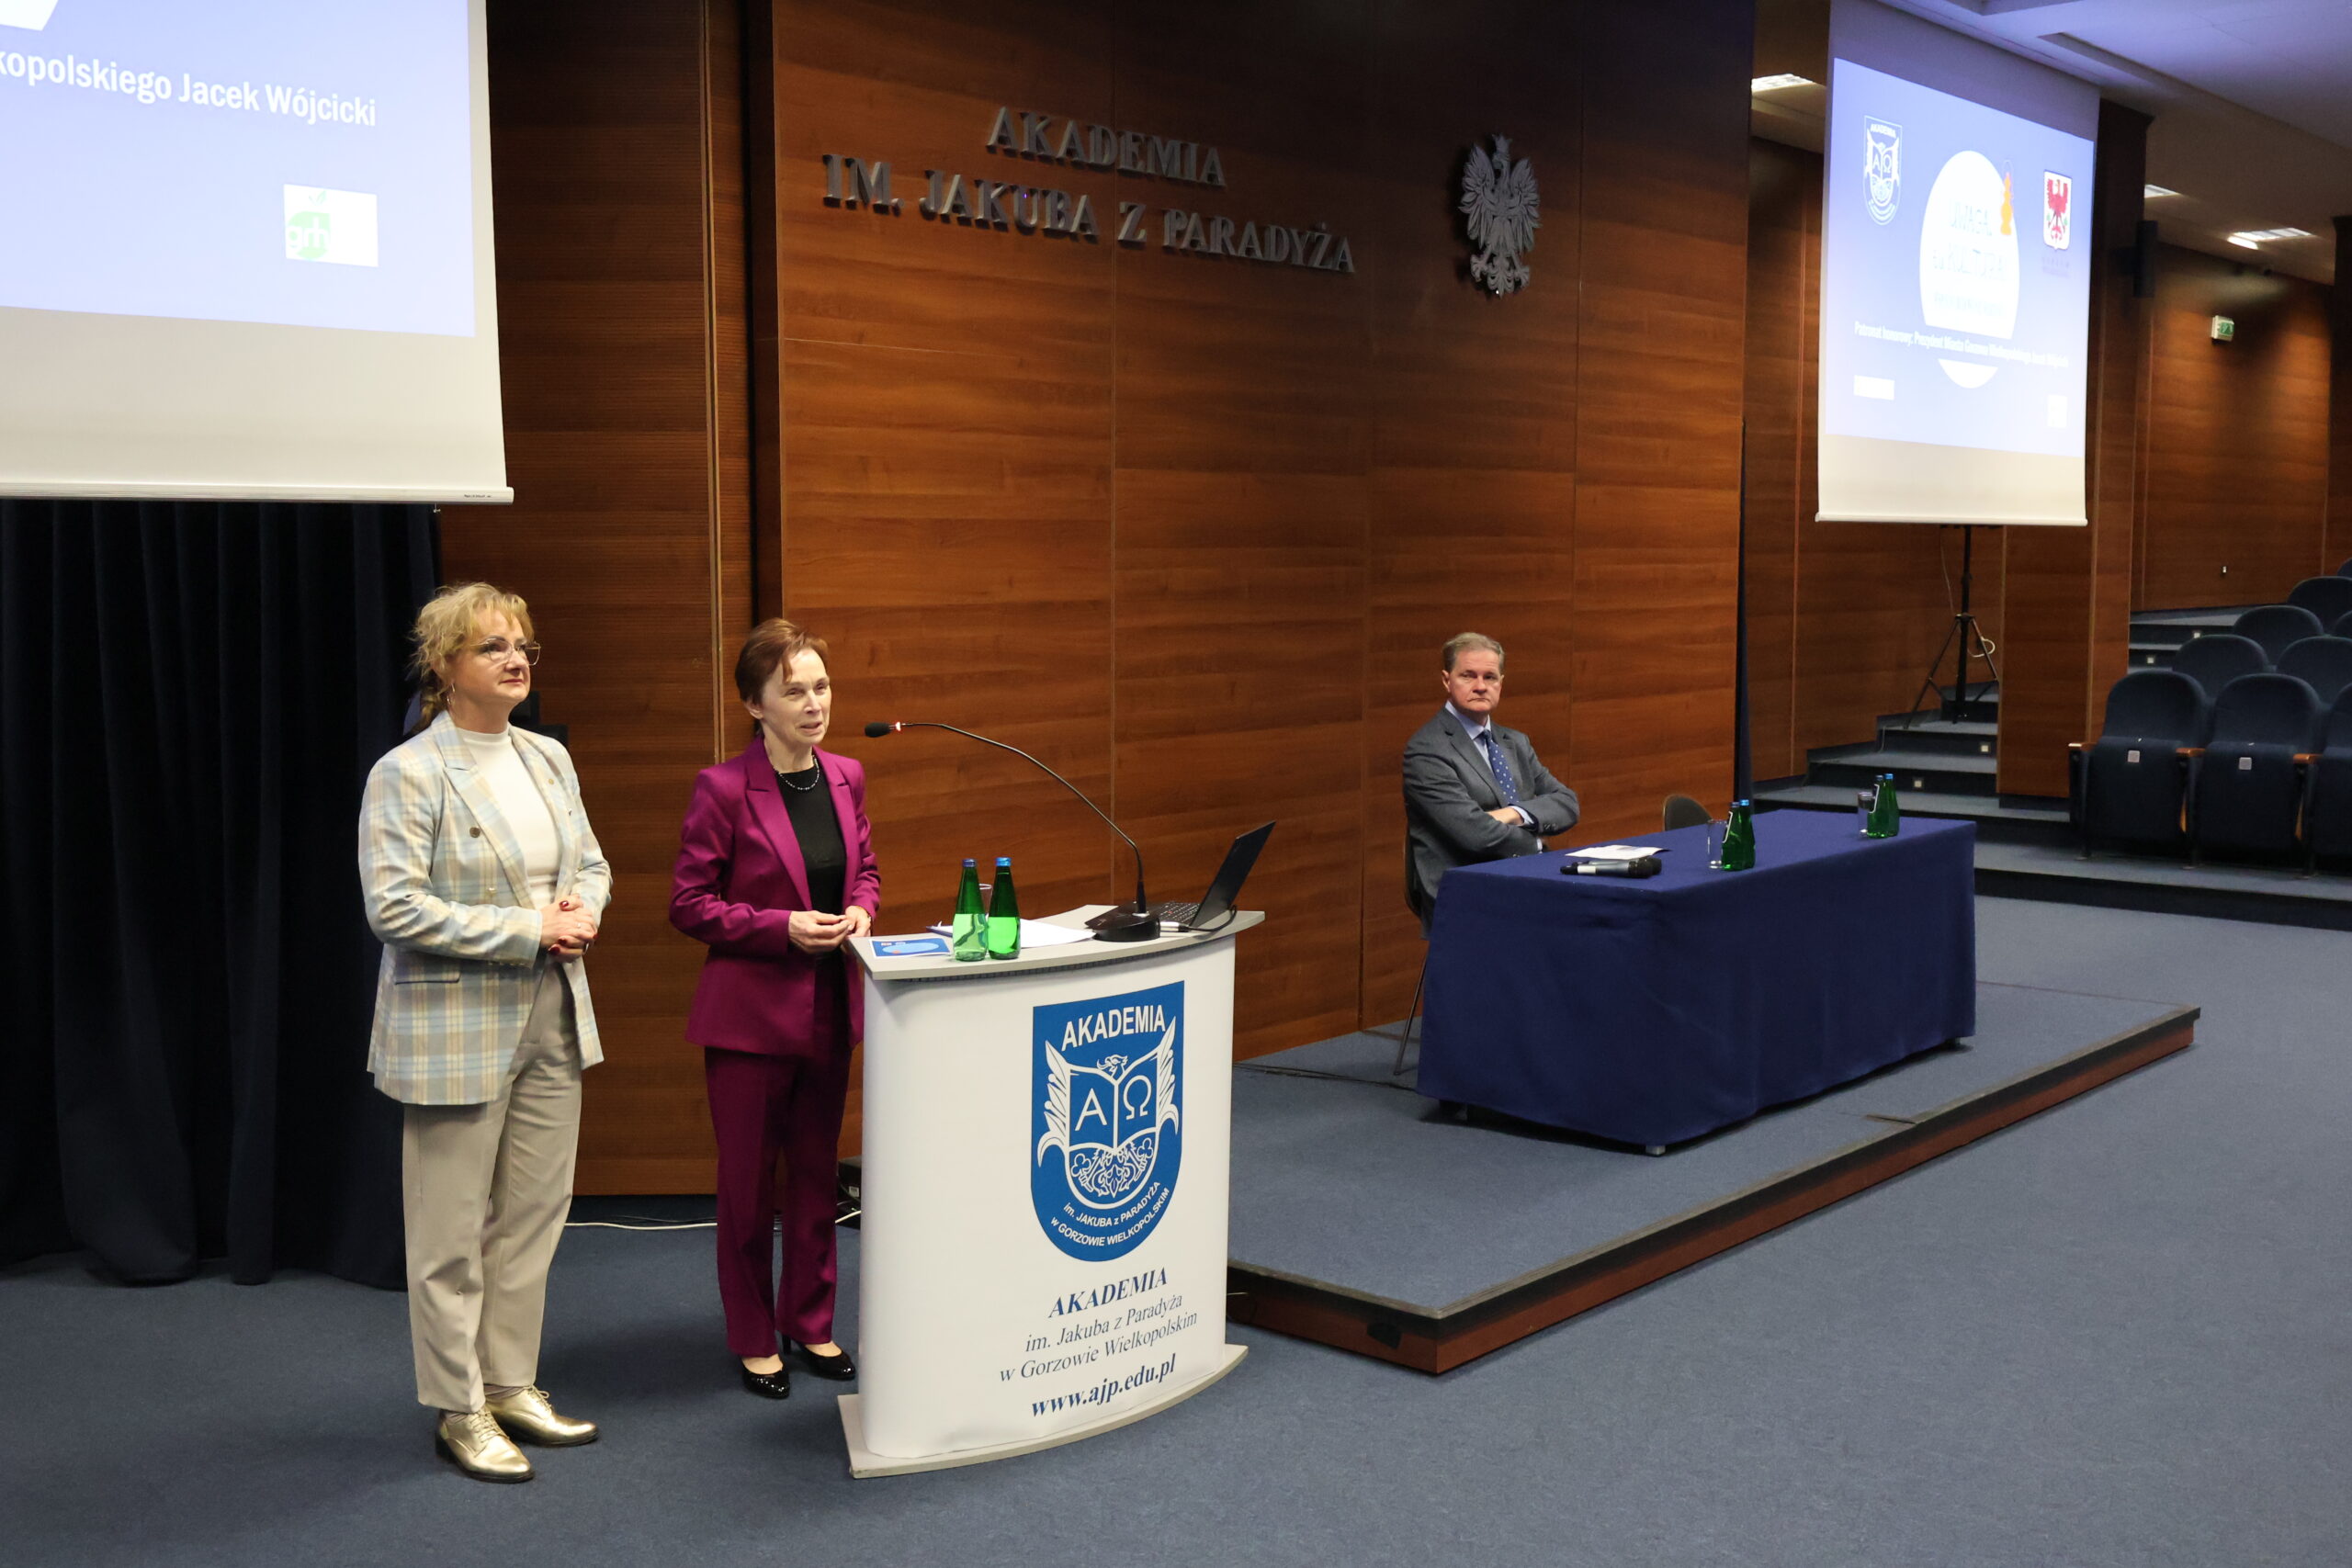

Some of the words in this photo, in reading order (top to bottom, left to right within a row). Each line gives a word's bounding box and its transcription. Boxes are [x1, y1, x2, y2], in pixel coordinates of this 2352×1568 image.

[177, 73, 260, 111] Jacek
[265, 85, 377, 126] Wójcicki
[986, 106, 1227, 187] AKADEMIA
[821, 152, 904, 217] IM.
[919, 169, 1100, 243] JAKUBA
[1117, 201, 1148, 243] Z
[1161, 208, 1355, 274] PARADYŻA
[1061, 1005, 1166, 1051] AKADEMIA
[1058, 1223, 1105, 1247] GORZOWIE
[1106, 1188, 1170, 1245] WIELKOPOLSKIM
[1063, 1202, 1075, 1220] im.
[1076, 1211, 1113, 1227] JAKUBA
[1120, 1181, 1160, 1223] PARADYŻA
[1025, 1334, 1051, 1352] im.
[1057, 1319, 1110, 1346] Jakuba
[1114, 1317, 1123, 1330] z
[1125, 1293, 1183, 1327] Paradyża
[1047, 1267, 1168, 1319] AKADEMIA
[1000, 1368, 1015, 1382] w
[1021, 1346, 1100, 1379] Gorzowie
[1104, 1311, 1198, 1357] Wielkopolskim
[1031, 1353, 1177, 1417] www.ajp.edu.pl
